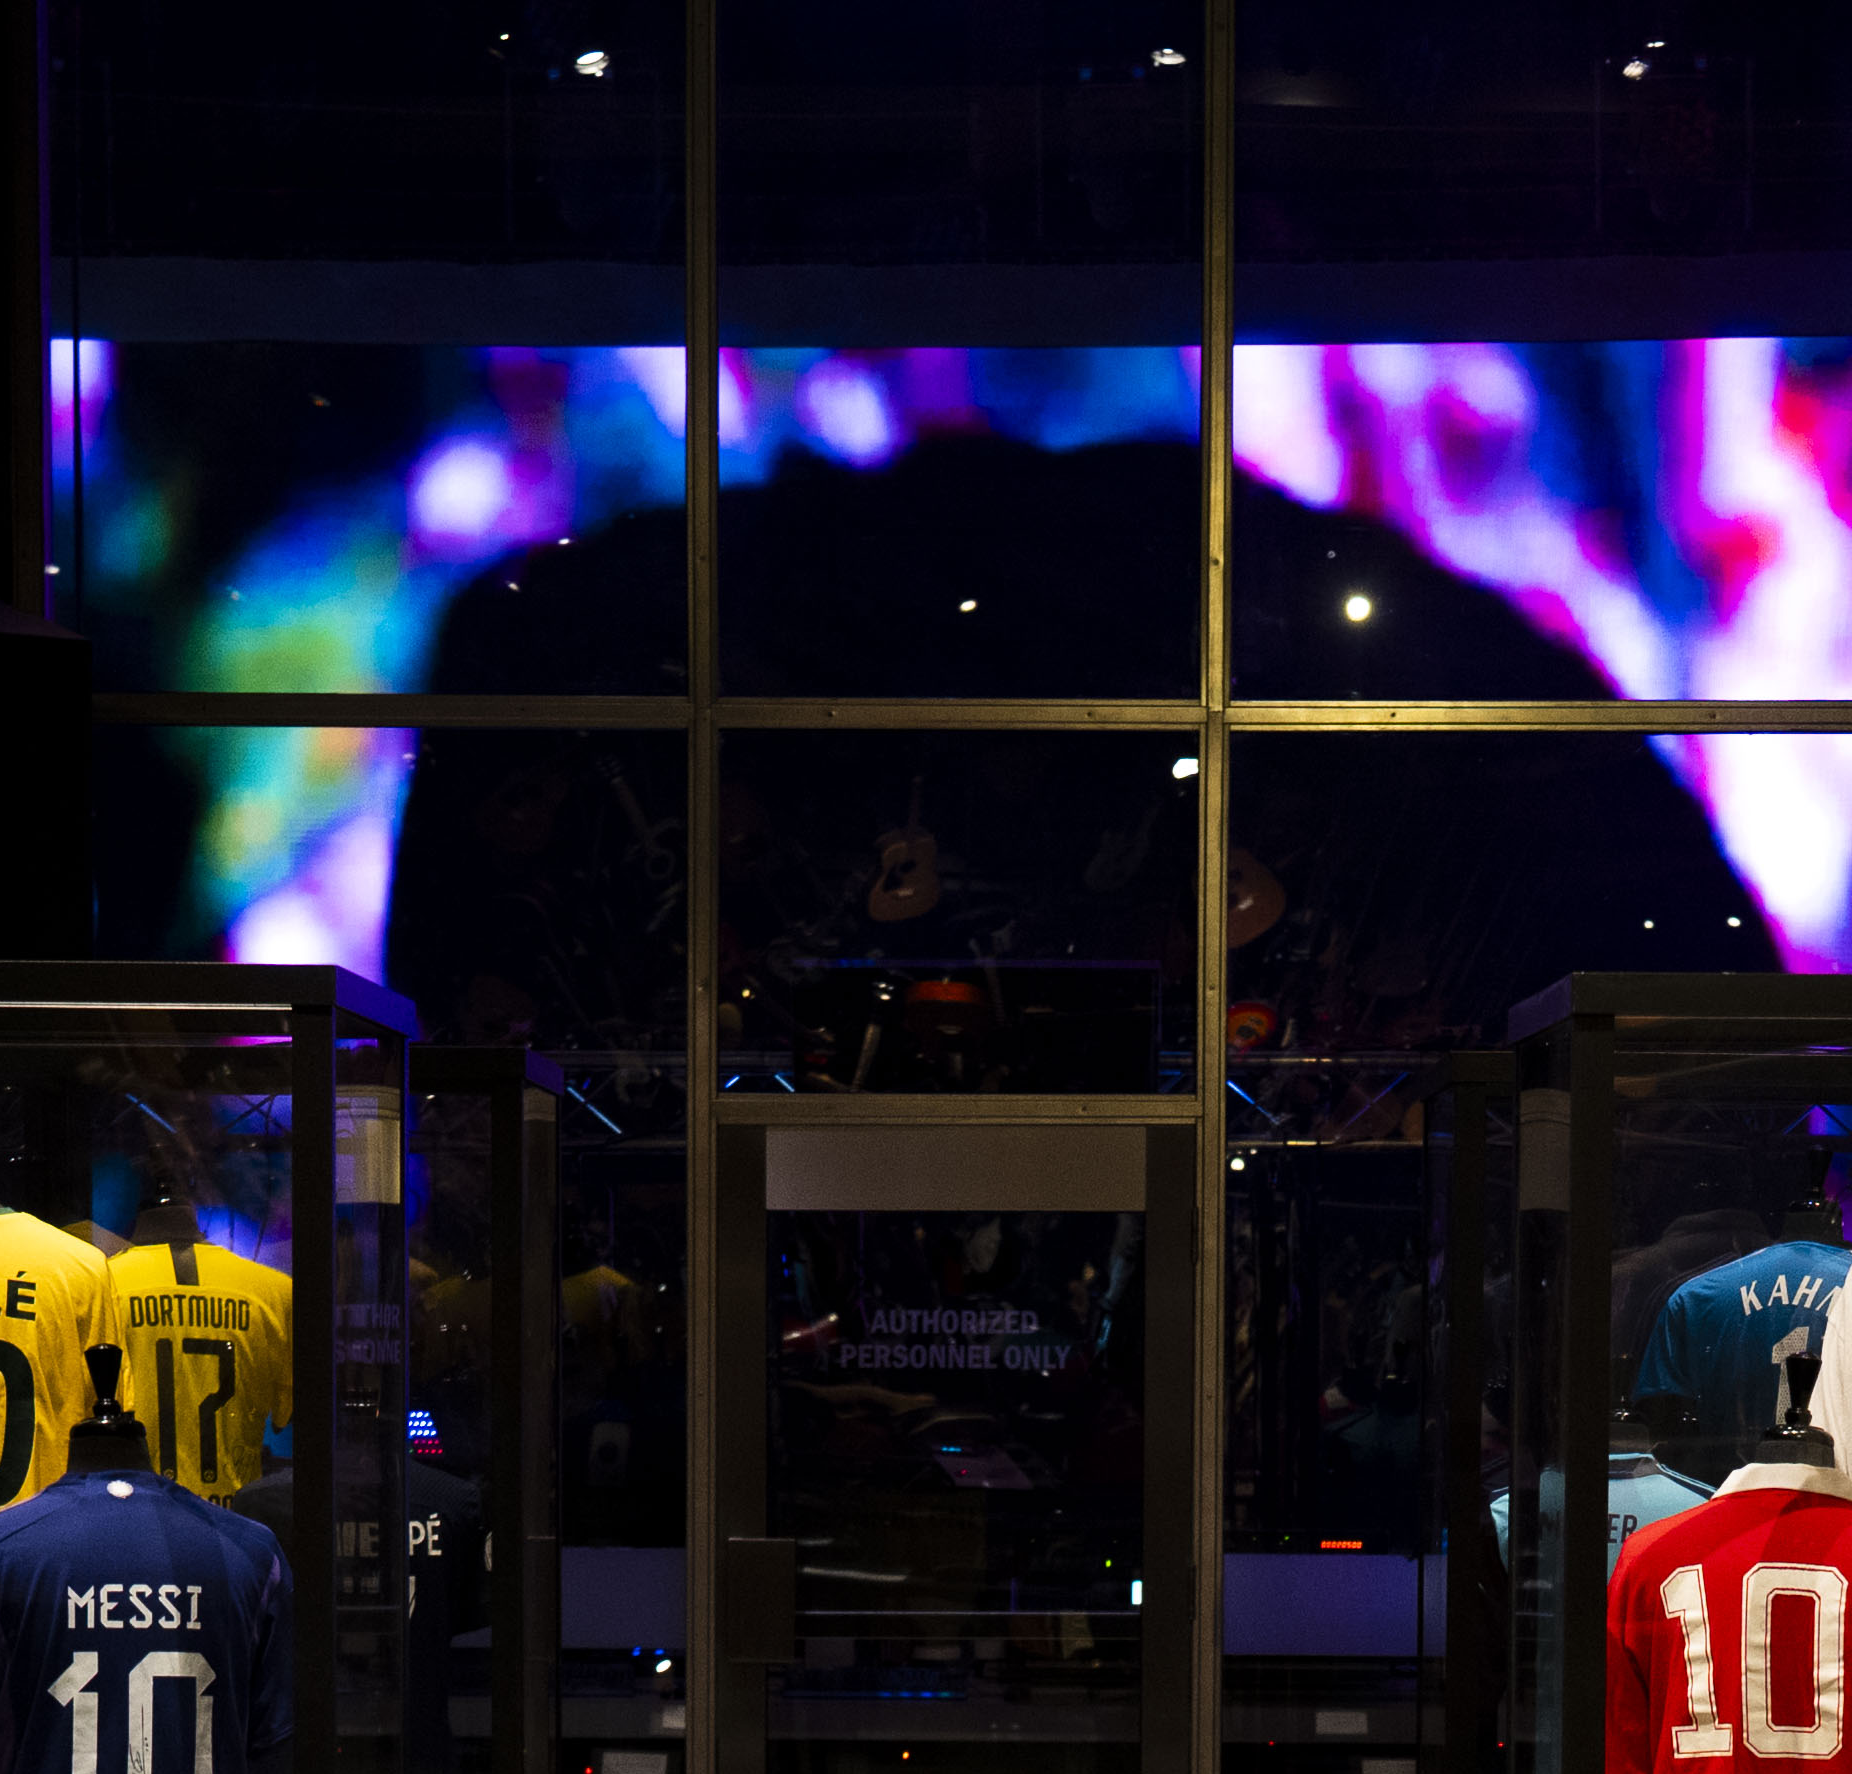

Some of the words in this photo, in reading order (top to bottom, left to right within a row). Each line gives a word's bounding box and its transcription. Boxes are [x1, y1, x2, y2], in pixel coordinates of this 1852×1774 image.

[129, 1294, 251, 1332] DORTMUND
[870, 1308, 1041, 1336] AUTHORIZED
[838, 1342, 999, 1370] PERSONNEL
[1003, 1342, 1073, 1370] ONLY
[155, 1337, 236, 1484] 17
[407, 1512, 443, 1558] PÉ
[1607, 1512, 1639, 1545] ER
[67, 1583, 203, 1630] MESSI
[1659, 1561, 1849, 1760] 10
